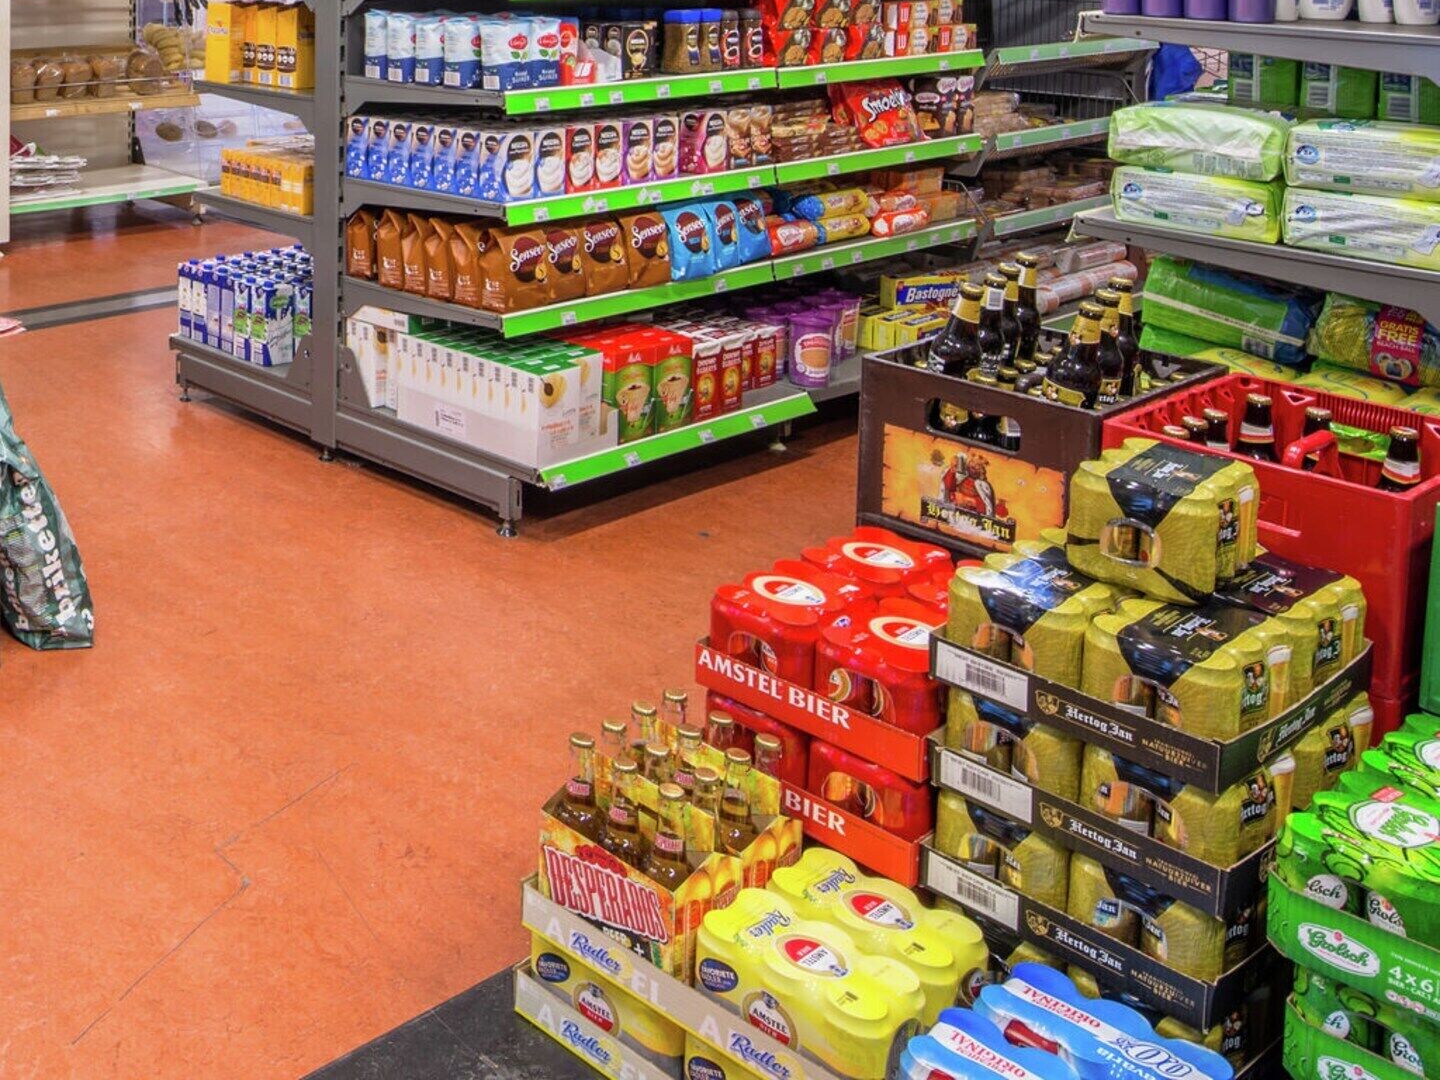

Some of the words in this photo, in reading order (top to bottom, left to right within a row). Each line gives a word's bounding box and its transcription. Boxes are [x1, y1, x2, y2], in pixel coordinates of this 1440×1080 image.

[584, 224, 618, 253] Senseo
[631, 221, 666, 249] Senseo
[905, 286, 959, 304] Bastogne
[1377, 328, 1418, 347] FREE
[1380, 320, 1419, 336] GRATIS
[981, 518, 1010, 539] Jan
[698, 648, 783, 701] AMSTEL
[788, 685, 851, 730] BIER
[1065, 704, 1108, 734] Hertog
[1108, 722, 1133, 742] Jan
[784, 787, 846, 837] BIER
[1069, 819, 1111, 850] Hertog
[1111, 838, 1137, 861] Jan
[544, 845, 668, 944] DESPERADOS
[571, 931, 622, 972] Radler
[1054, 926, 1097, 960] Hertog
[1097, 949, 1122, 972] Jan
[1307, 928, 1370, 967] Grolsch
[752, 1007, 788, 1035] AMSTEL
[562, 1019, 611, 1065] Radler
[728, 1031, 791, 1080] Radler
